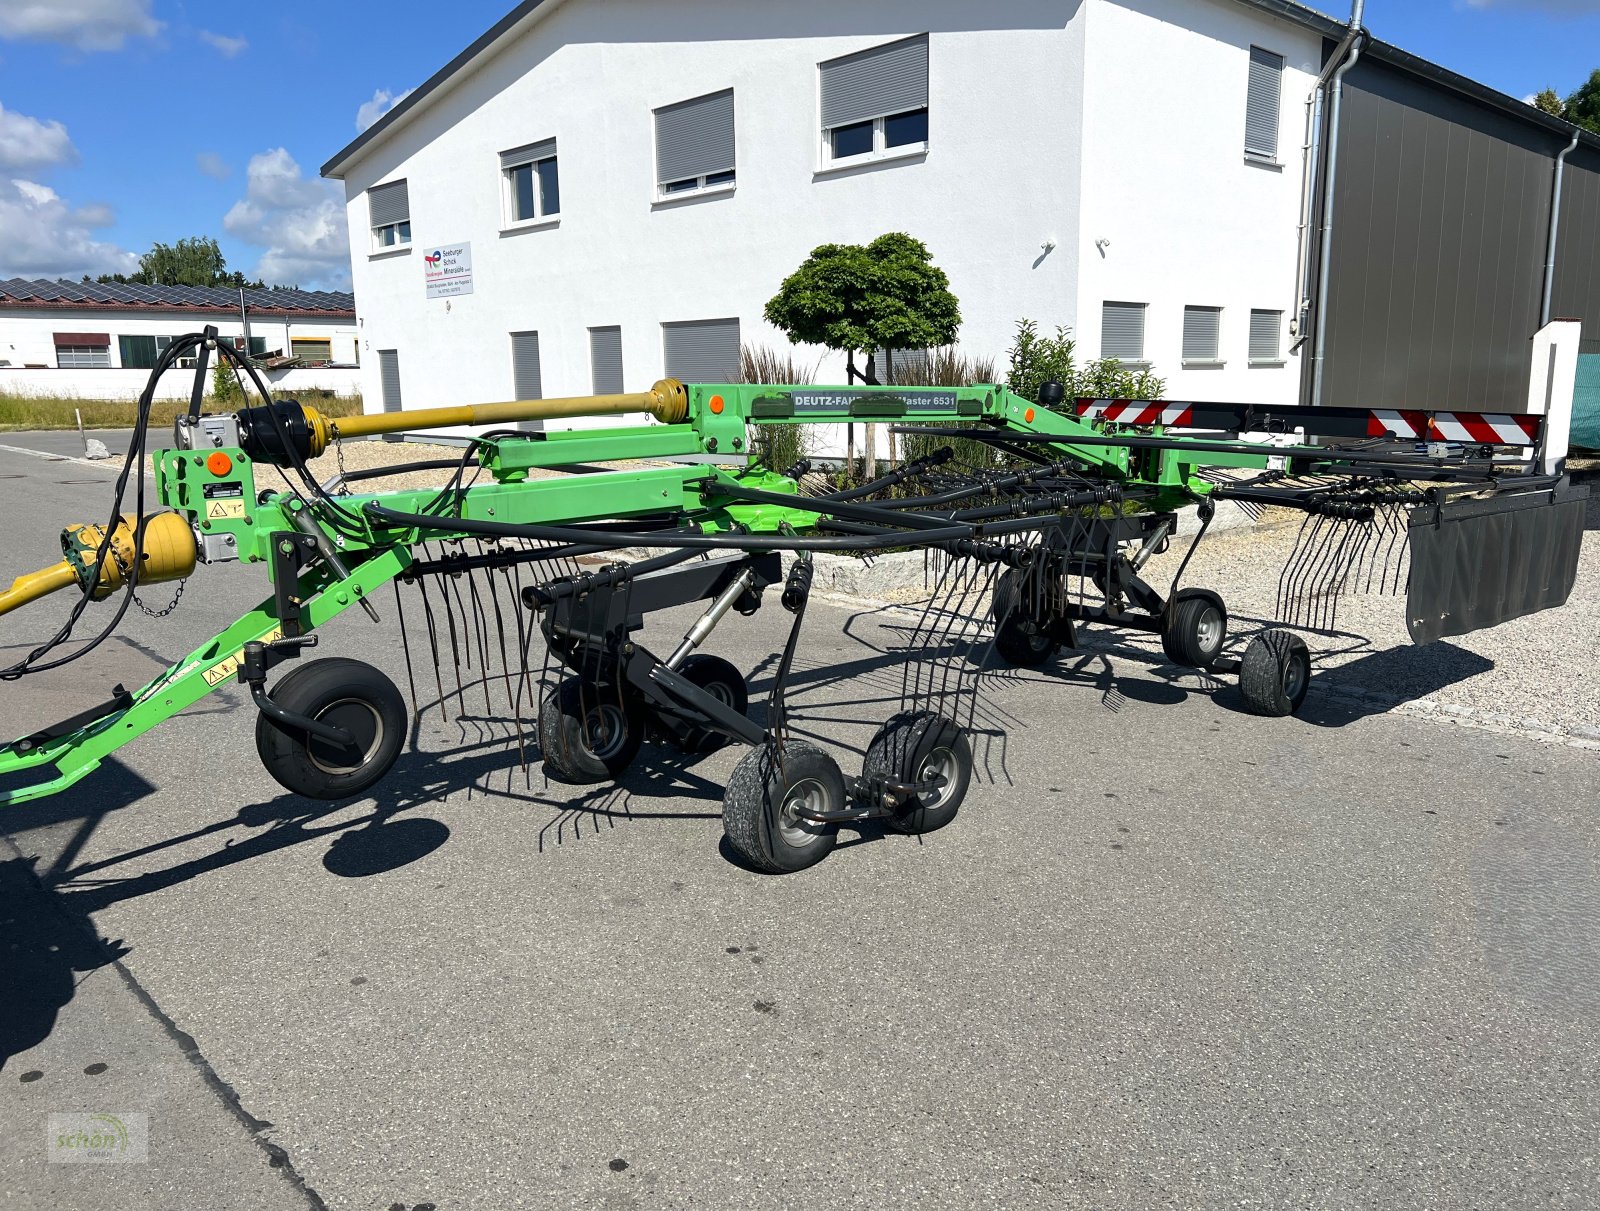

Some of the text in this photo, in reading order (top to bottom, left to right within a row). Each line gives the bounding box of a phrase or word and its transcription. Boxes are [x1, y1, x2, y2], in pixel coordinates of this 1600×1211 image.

[442, 249, 463, 257] Seeburger
[795, 396, 863, 406] DEUTZ-FAH
[933, 396, 955, 406] 6531
